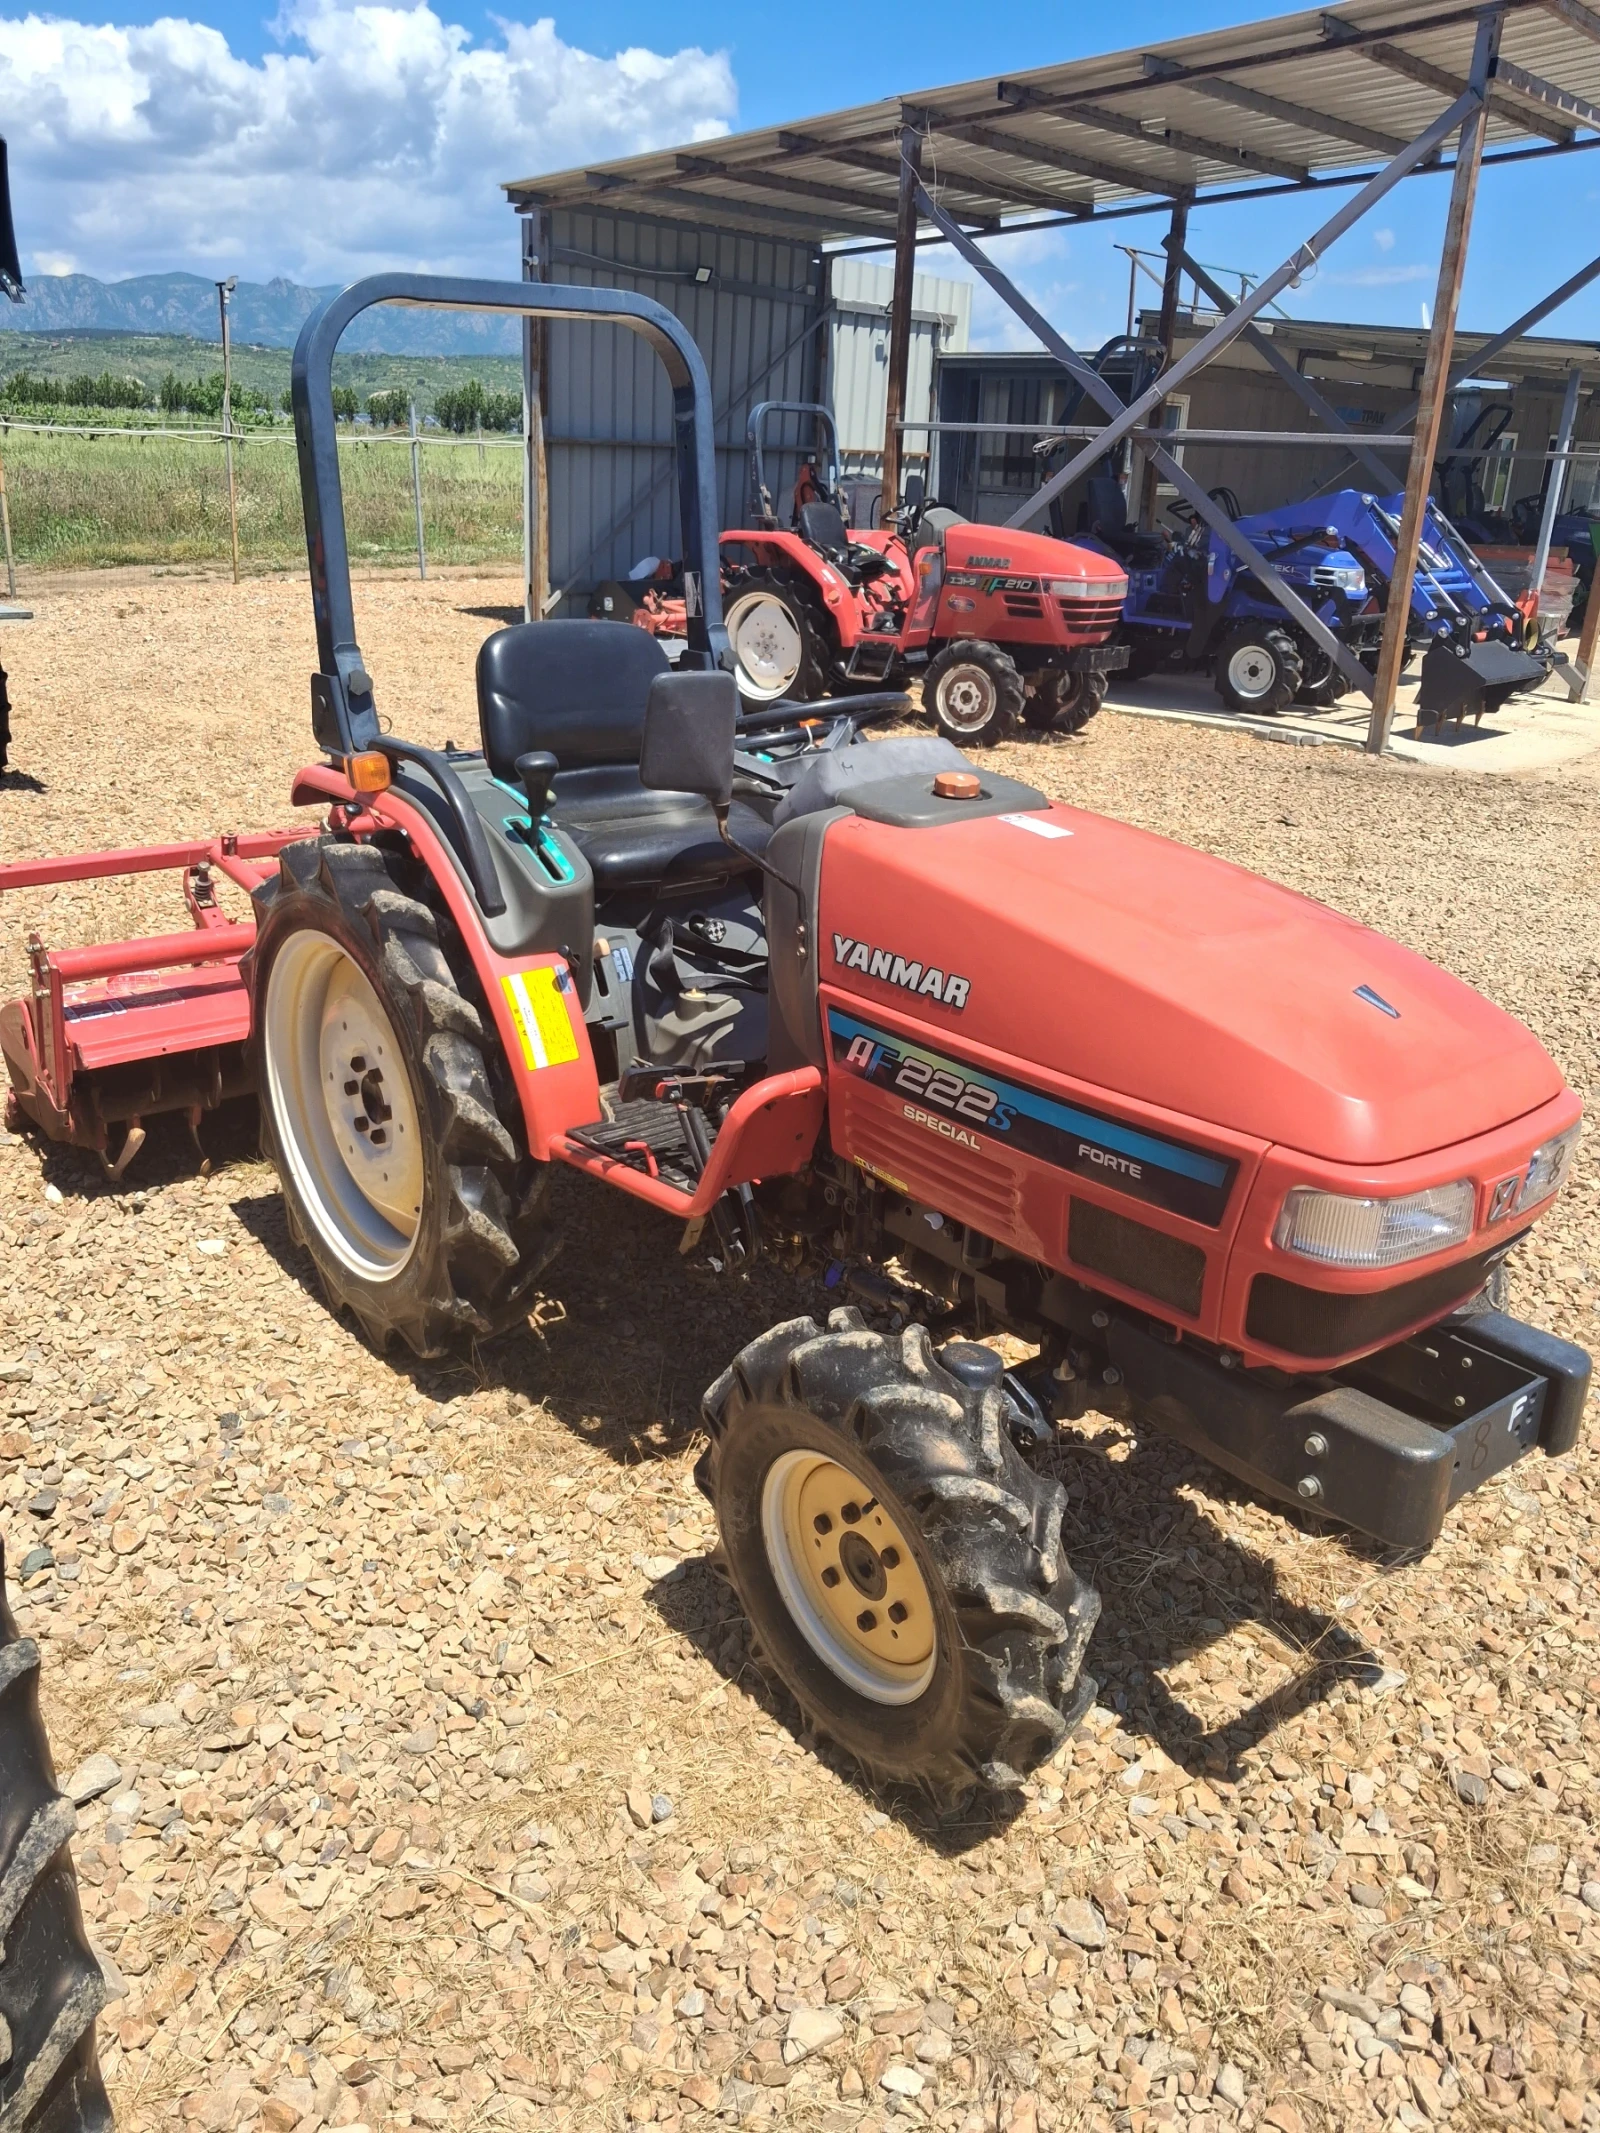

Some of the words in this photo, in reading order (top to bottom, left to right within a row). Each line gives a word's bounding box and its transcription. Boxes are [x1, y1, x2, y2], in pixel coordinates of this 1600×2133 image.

[1271, 564, 1295, 574] EKI
[832, 932, 971, 1009] YANMAR
[902, 1104, 982, 1150] SPECIAL
[1078, 1143, 1143, 1180] FORTE
[1507, 1395, 1528, 1432] F
[1471, 1420, 1491, 1471] 8
